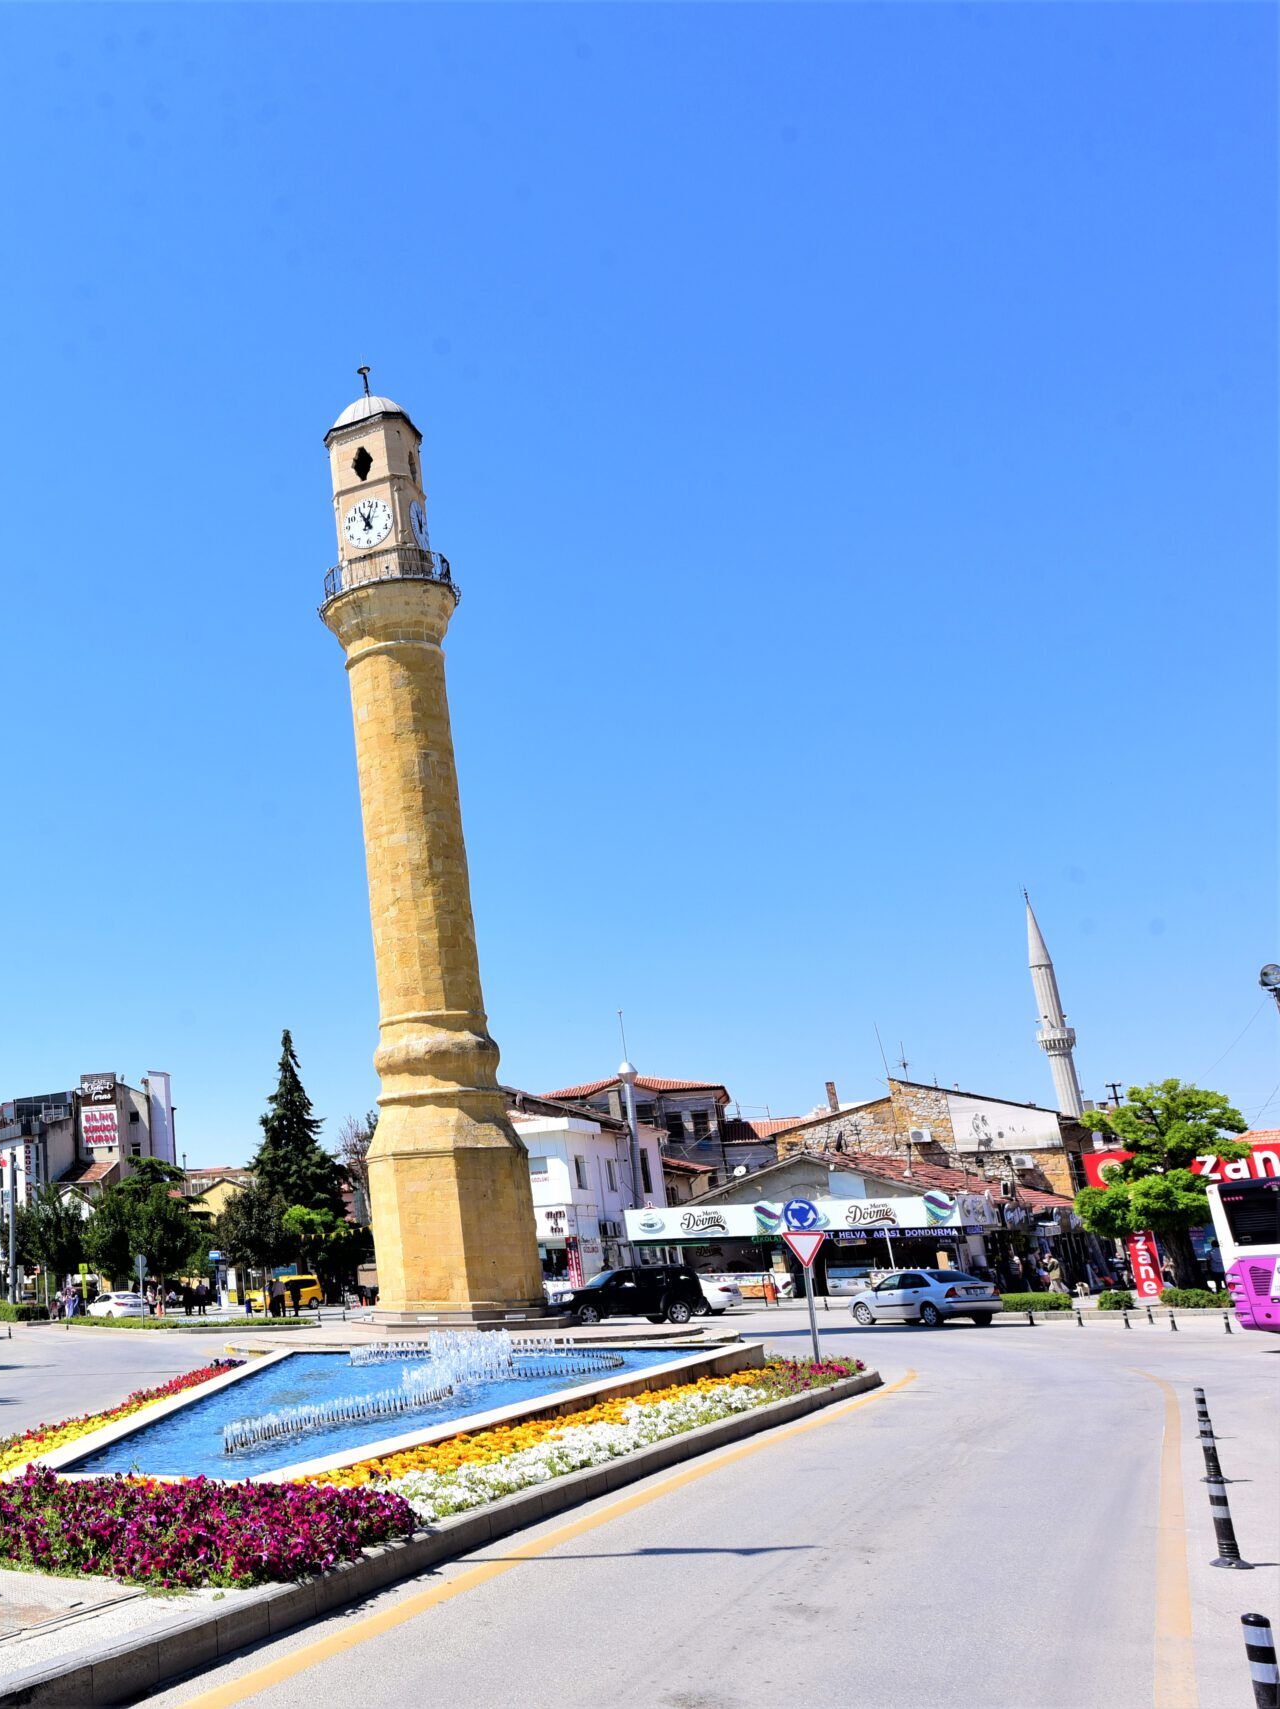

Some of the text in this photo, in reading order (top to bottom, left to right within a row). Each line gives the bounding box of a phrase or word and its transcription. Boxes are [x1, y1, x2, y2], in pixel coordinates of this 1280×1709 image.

[85, 1133, 117, 1144] KURSU
[839, 1231, 867, 1239] HELVA
[873, 1229, 900, 1238] ARASI
[905, 1228, 958, 1237] DONDURMA
